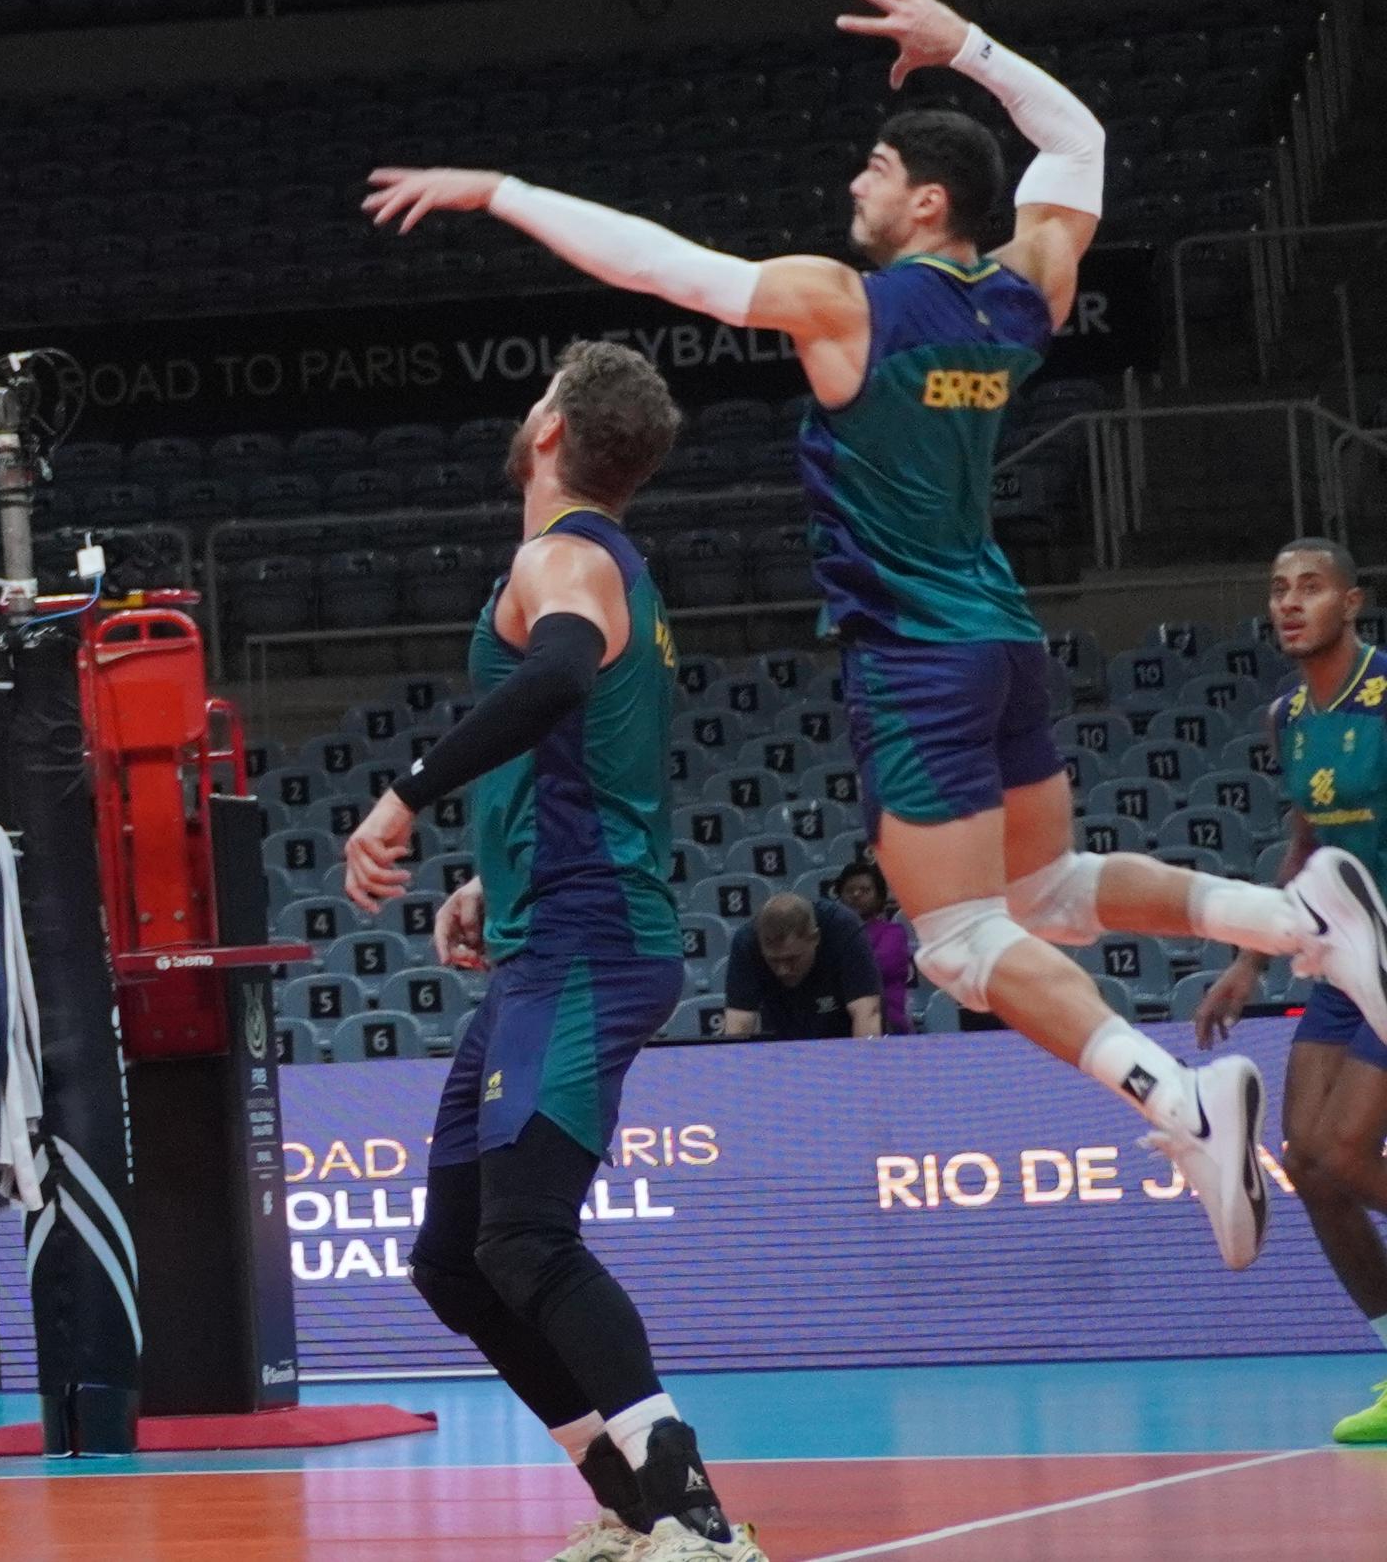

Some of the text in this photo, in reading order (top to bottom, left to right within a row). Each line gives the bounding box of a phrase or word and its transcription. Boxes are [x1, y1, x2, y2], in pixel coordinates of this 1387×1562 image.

[215, 353, 283, 396] TO
[299, 342, 443, 392] PARIS
[456, 322, 796, 382] VOLYBALL
[282, 1124, 721, 1183] OAD RIS
[876, 1151, 1001, 1210] RIO
[1021, 1145, 1124, 1205] DE
